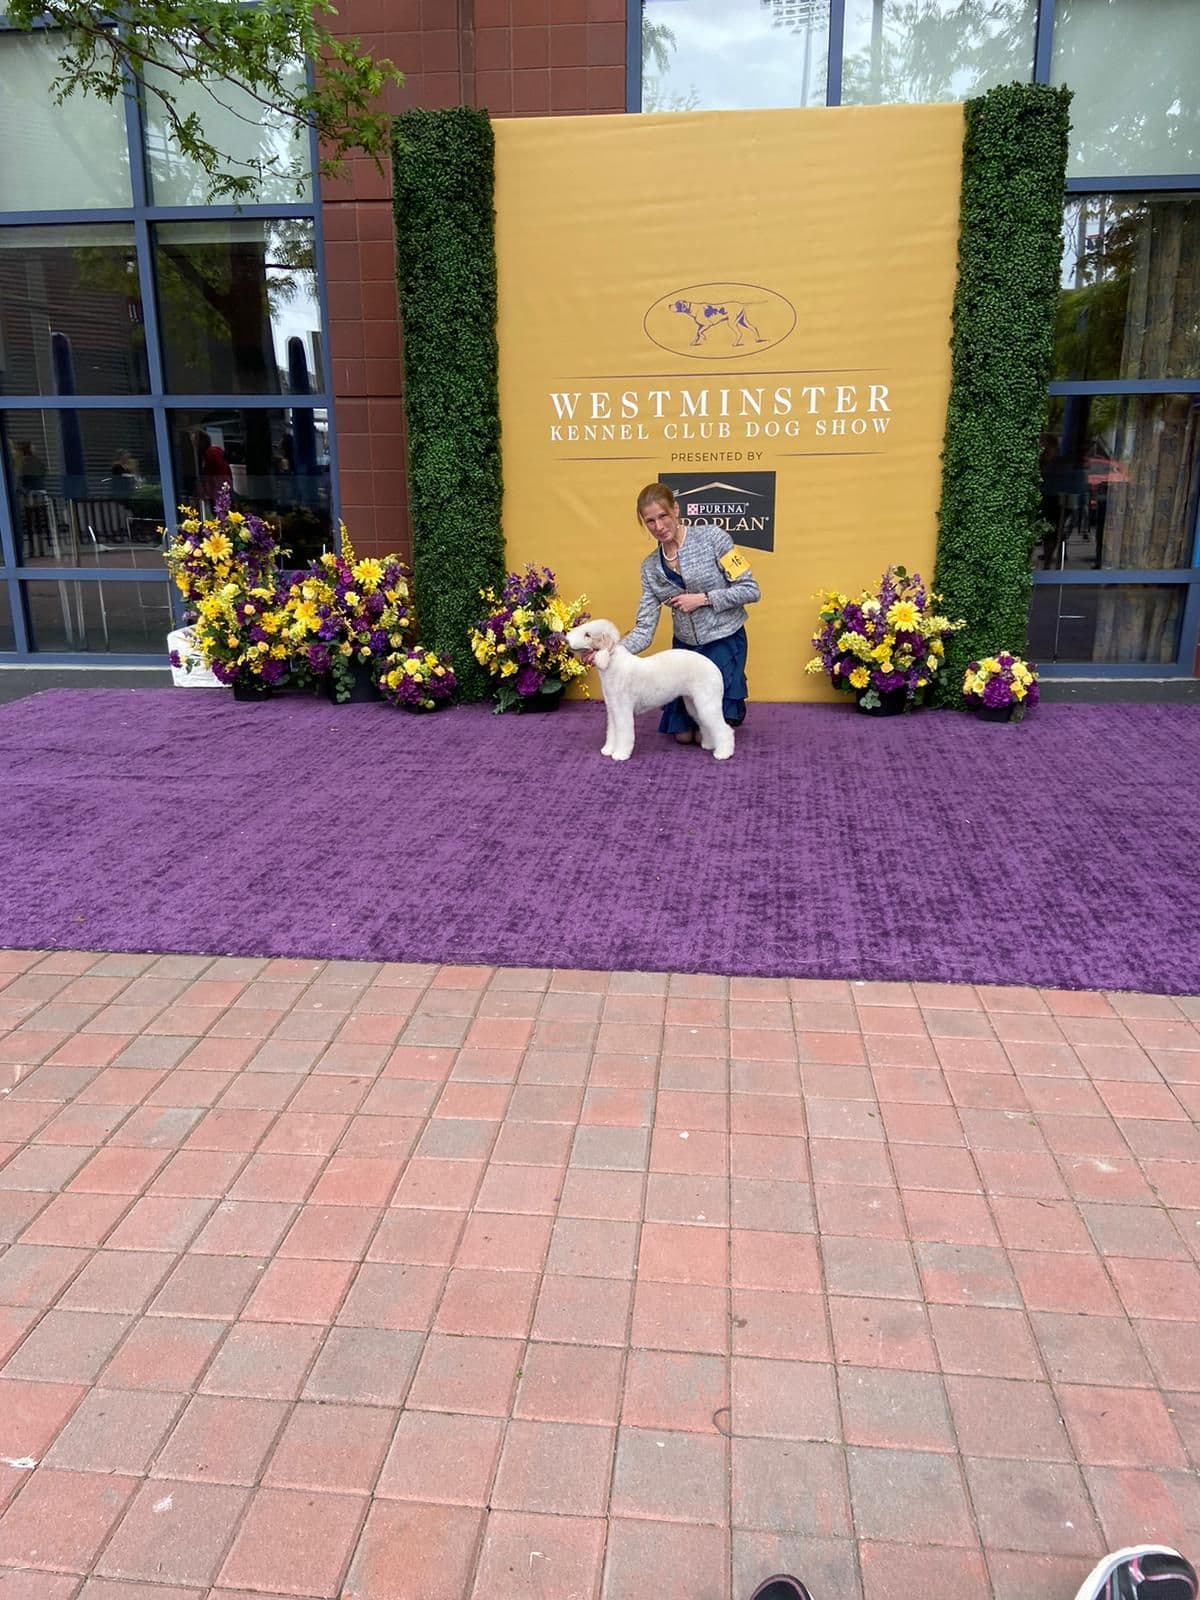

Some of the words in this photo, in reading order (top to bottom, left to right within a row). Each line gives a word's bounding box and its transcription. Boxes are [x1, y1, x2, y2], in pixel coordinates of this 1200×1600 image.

[550, 384, 892, 421] WESTMINSTER
[550, 423, 650, 442] KENNEL
[664, 421, 732, 440] CLUB
[745, 419, 801, 438] DOG
[815, 417, 892, 436] SHOW
[671, 451, 743, 462] PRESENTED
[747, 451, 764, 461] BY
[699, 504, 743, 514] PURINA
[712, 516, 765, 531] PLAN
